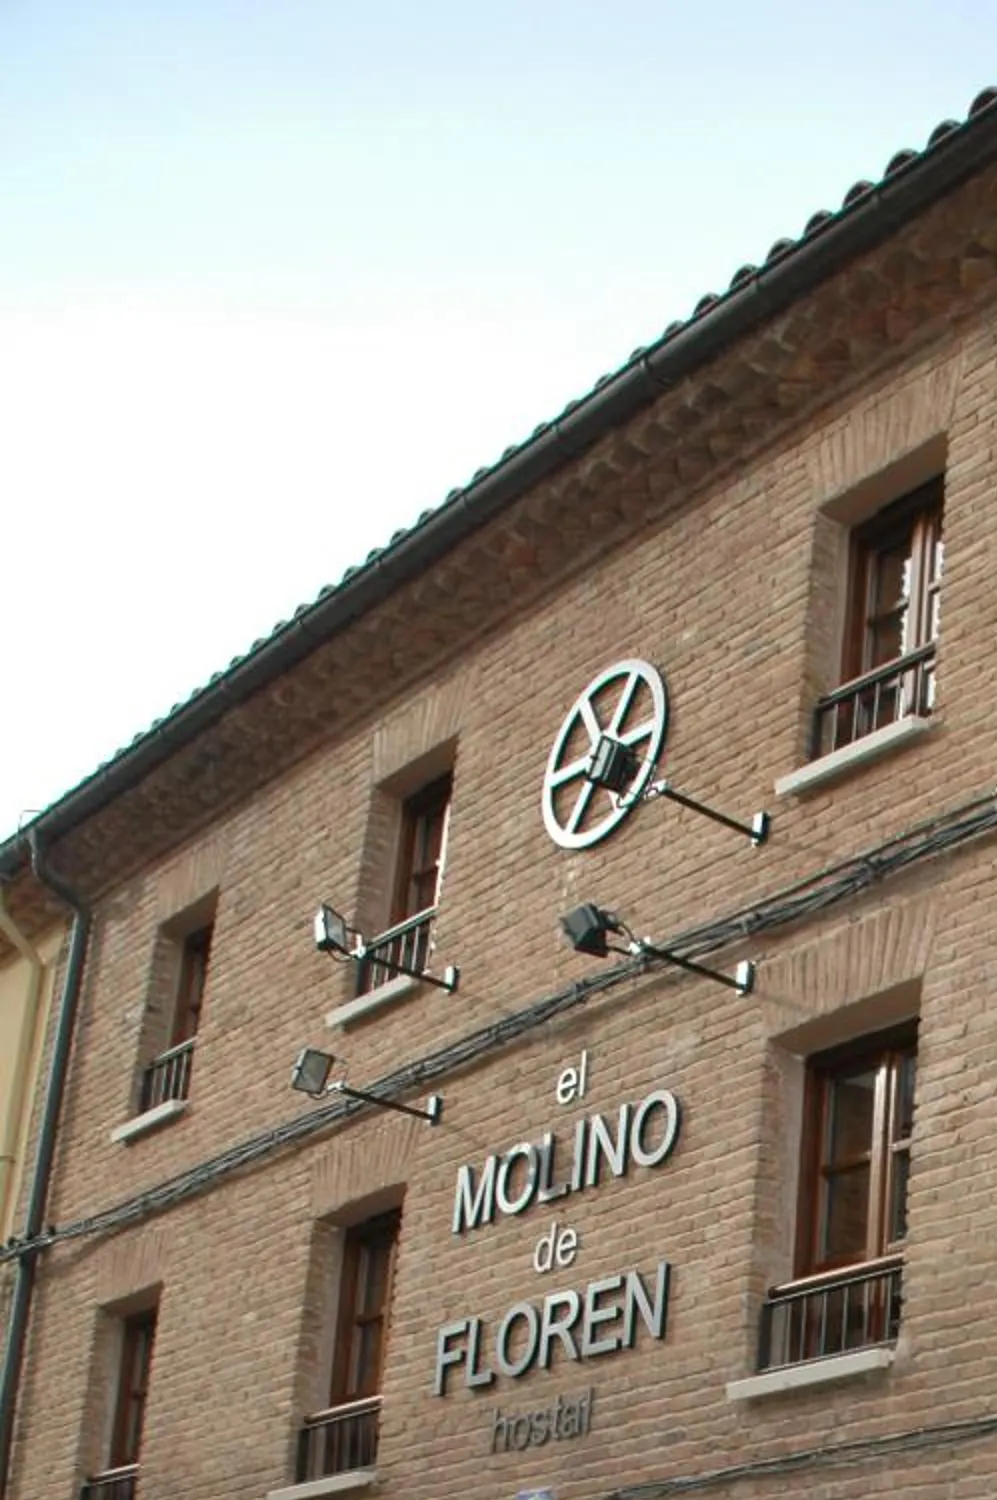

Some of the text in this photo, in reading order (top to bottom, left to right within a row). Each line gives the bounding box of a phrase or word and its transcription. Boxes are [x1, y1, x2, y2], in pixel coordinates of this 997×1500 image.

[556, 1050, 588, 1105] el
[452, 1089, 680, 1234] MOLINO
[533, 1221, 578, 1274] de
[433, 1261, 671, 1397] FLOREN
[491, 1387, 594, 1454] hostal
